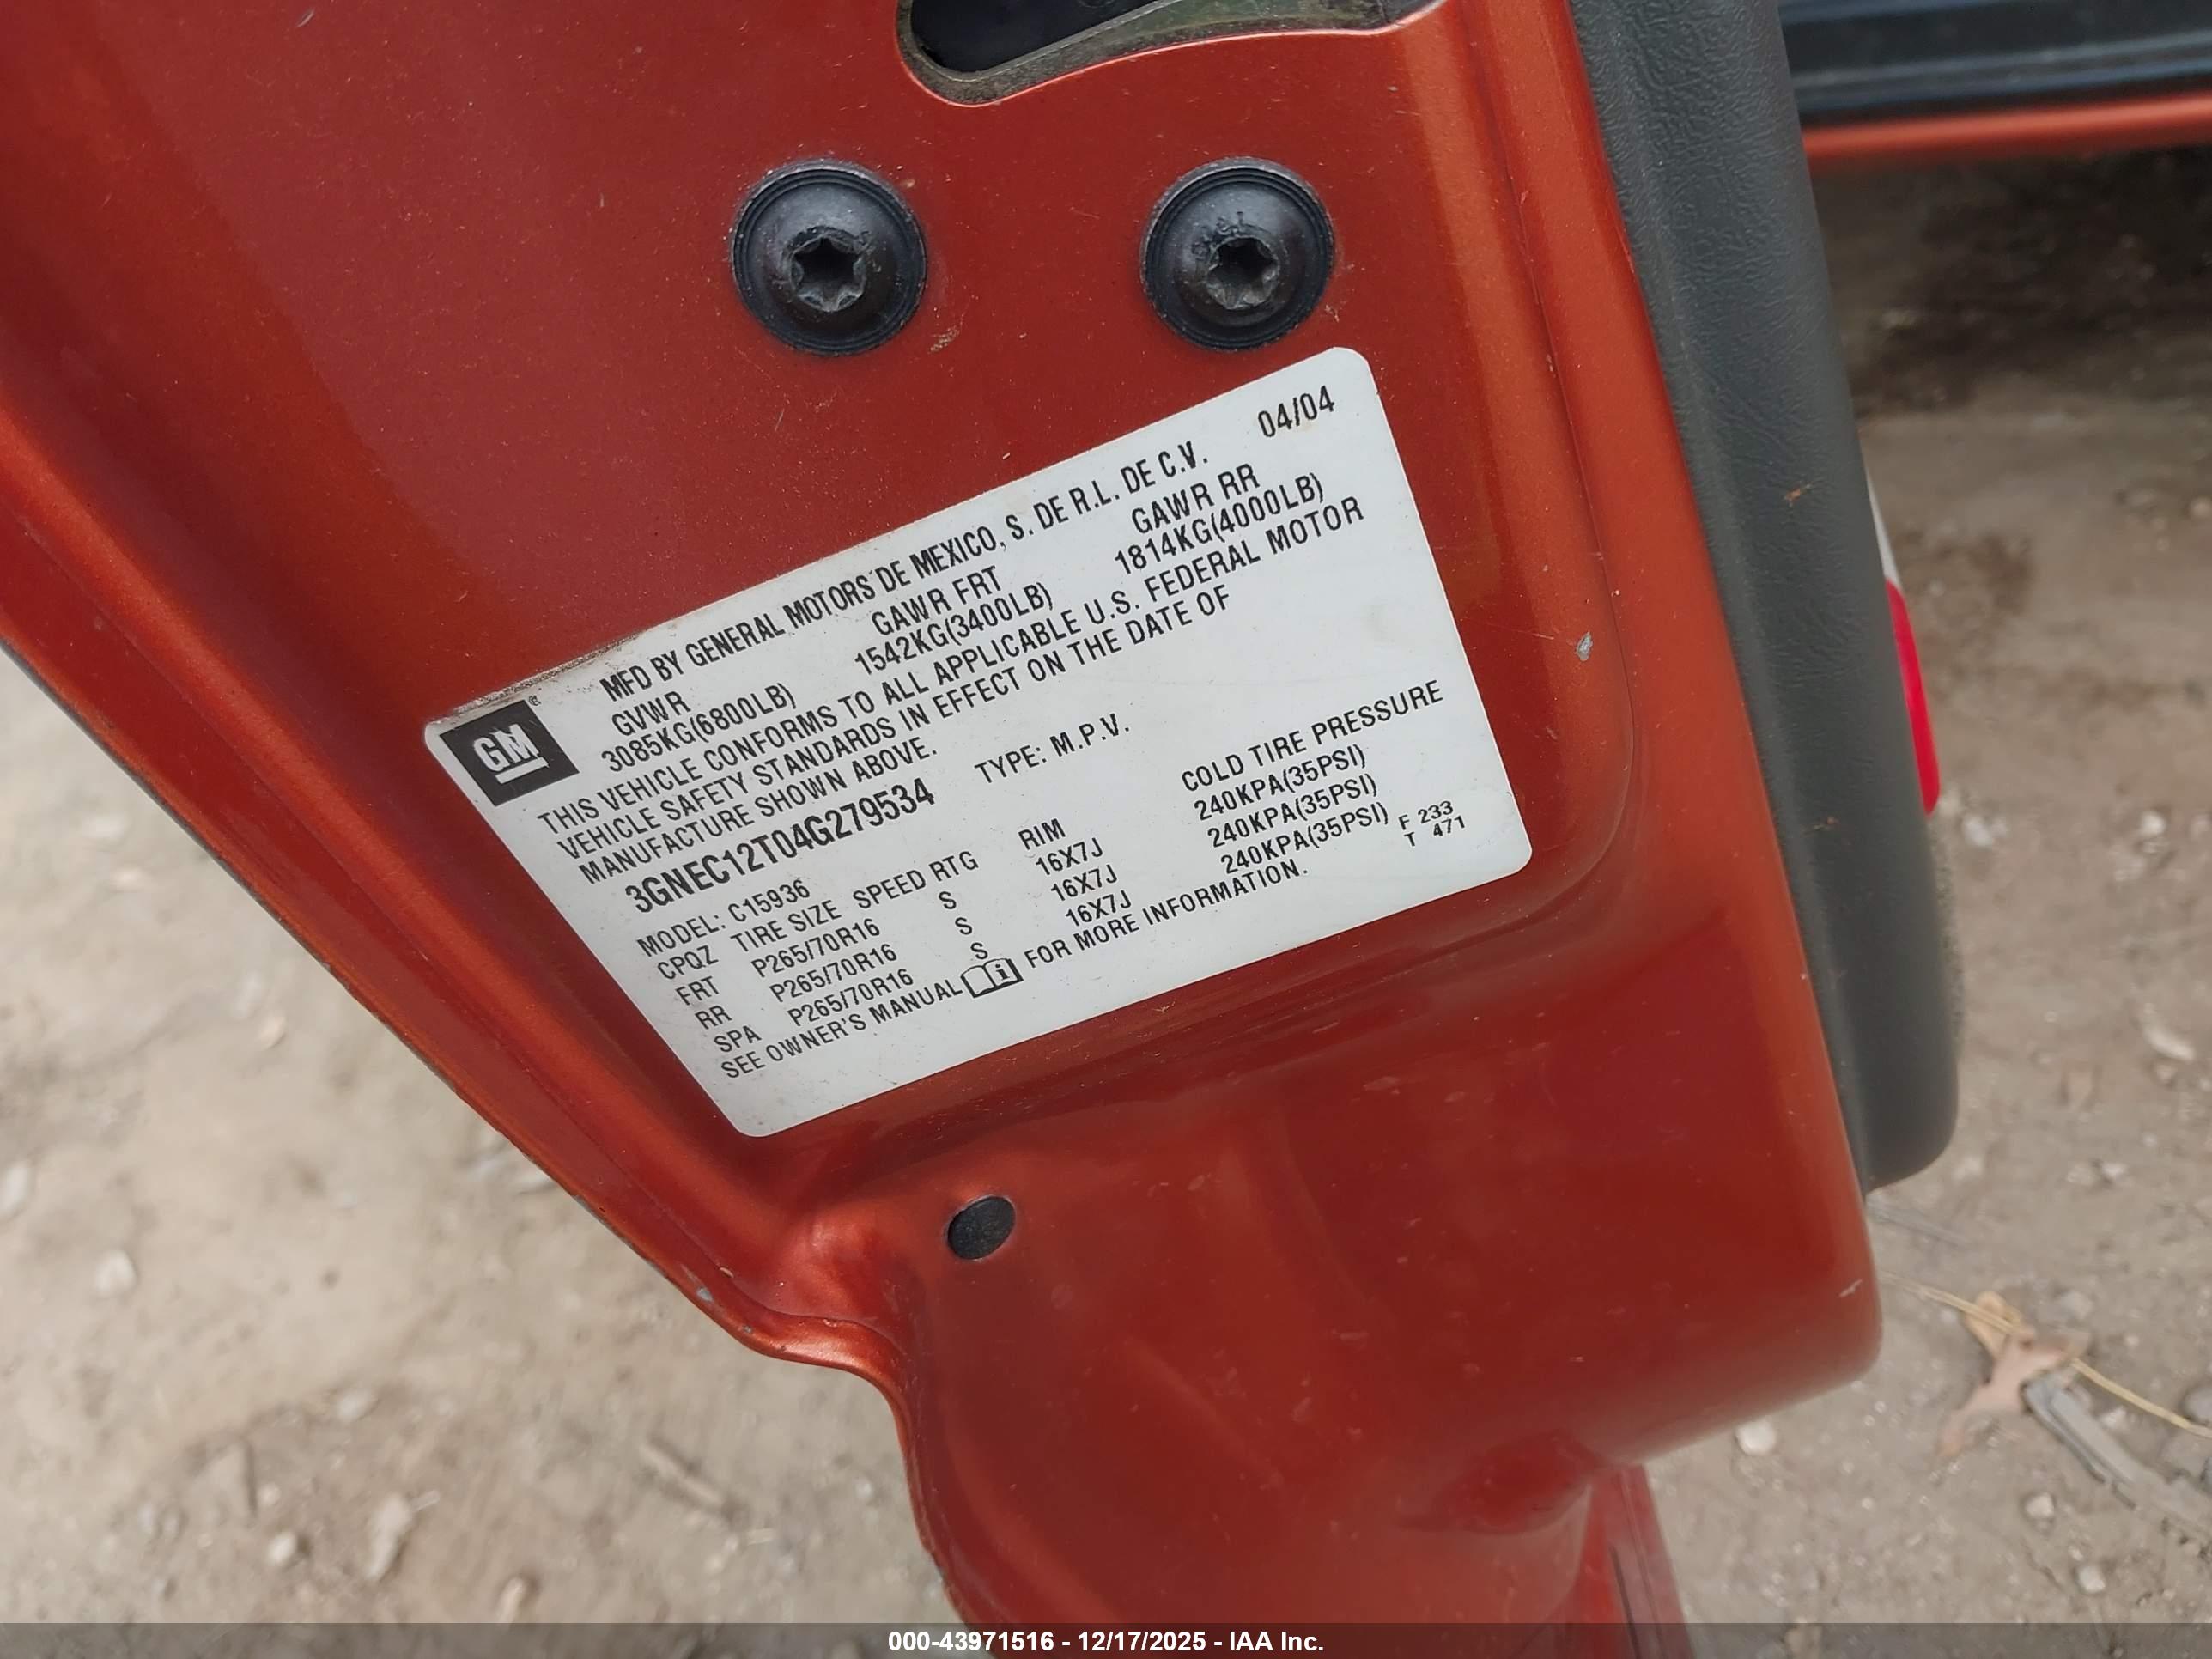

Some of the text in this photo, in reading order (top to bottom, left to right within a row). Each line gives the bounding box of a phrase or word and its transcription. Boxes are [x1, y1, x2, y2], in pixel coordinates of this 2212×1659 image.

[1256, 384, 1334, 438] 04/04
[1114, 471, 1323, 574] 1814KG(4000LB)
[1131, 462, 1261, 534] GAWR RR
[598, 440, 1208, 702] MFD BY GENERAL MOTORS DE MEXICO, S. DE R.L. DE C.V.
[871, 564, 1001, 636] GAWR FRT
[854, 581, 1053, 675] 1542KG(3400LB)
[536, 495, 1364, 835] THIS VEHICLE CONFORMS TO ALL APPLICABLE U.S. FEDERAL MOTOR
[556, 583, 1229, 860] VEHICLE SAFETY STANDARDS IN EFFECT ON THE DATE OF
[600, 682, 797, 772] 3085KG(6800LB)
[611, 690, 691, 737] GVWR
[1180, 678, 1443, 792] COLD TIRE PRESSURE
[473, 723, 540, 772] GM
[973, 712, 1129, 783] TYPE: M.P.V.
[577, 735, 937, 884] MANUFACTURE SHOWN ABOVE.
[1193, 743, 1365, 821] 240KPA(35PSI)
[1206, 772, 1377, 848] 240KPA(35PSI)
[623, 776, 935, 913] 3GNEC12T04G279534
[1017, 817, 1066, 850] RIM
[1219, 800, 1389, 874] 240KPA(35PSI)
[1397, 799, 1454, 830] F 233
[1403, 814, 1465, 847] T 471
[851, 850, 979, 909] SPEED RTG
[1034, 836, 1103, 876] 16X7J
[1049, 863, 1118, 902] 16X7J
[635, 878, 811, 957] MODEL: C15936
[729, 898, 842, 952] TIRE SIZE
[937, 890, 957, 910] S
[953, 915, 973, 935] S
[1023, 857, 1308, 969] FOR MORE INFORMATION.
[1064, 889, 1132, 927] 16X7J
[656, 944, 719, 980] CPQZ
[750, 917, 880, 978] P265/70R16
[768, 943, 897, 1003] P265/70R16
[969, 941, 988, 960] S
[673, 975, 720, 1006] FRT
[693, 1004, 732, 1030] RR
[786, 967, 914, 1027] P265/70R16
[713, 1024, 762, 1053] SPA
[720, 978, 963, 1079] SEE OWNER'S MANUAL
